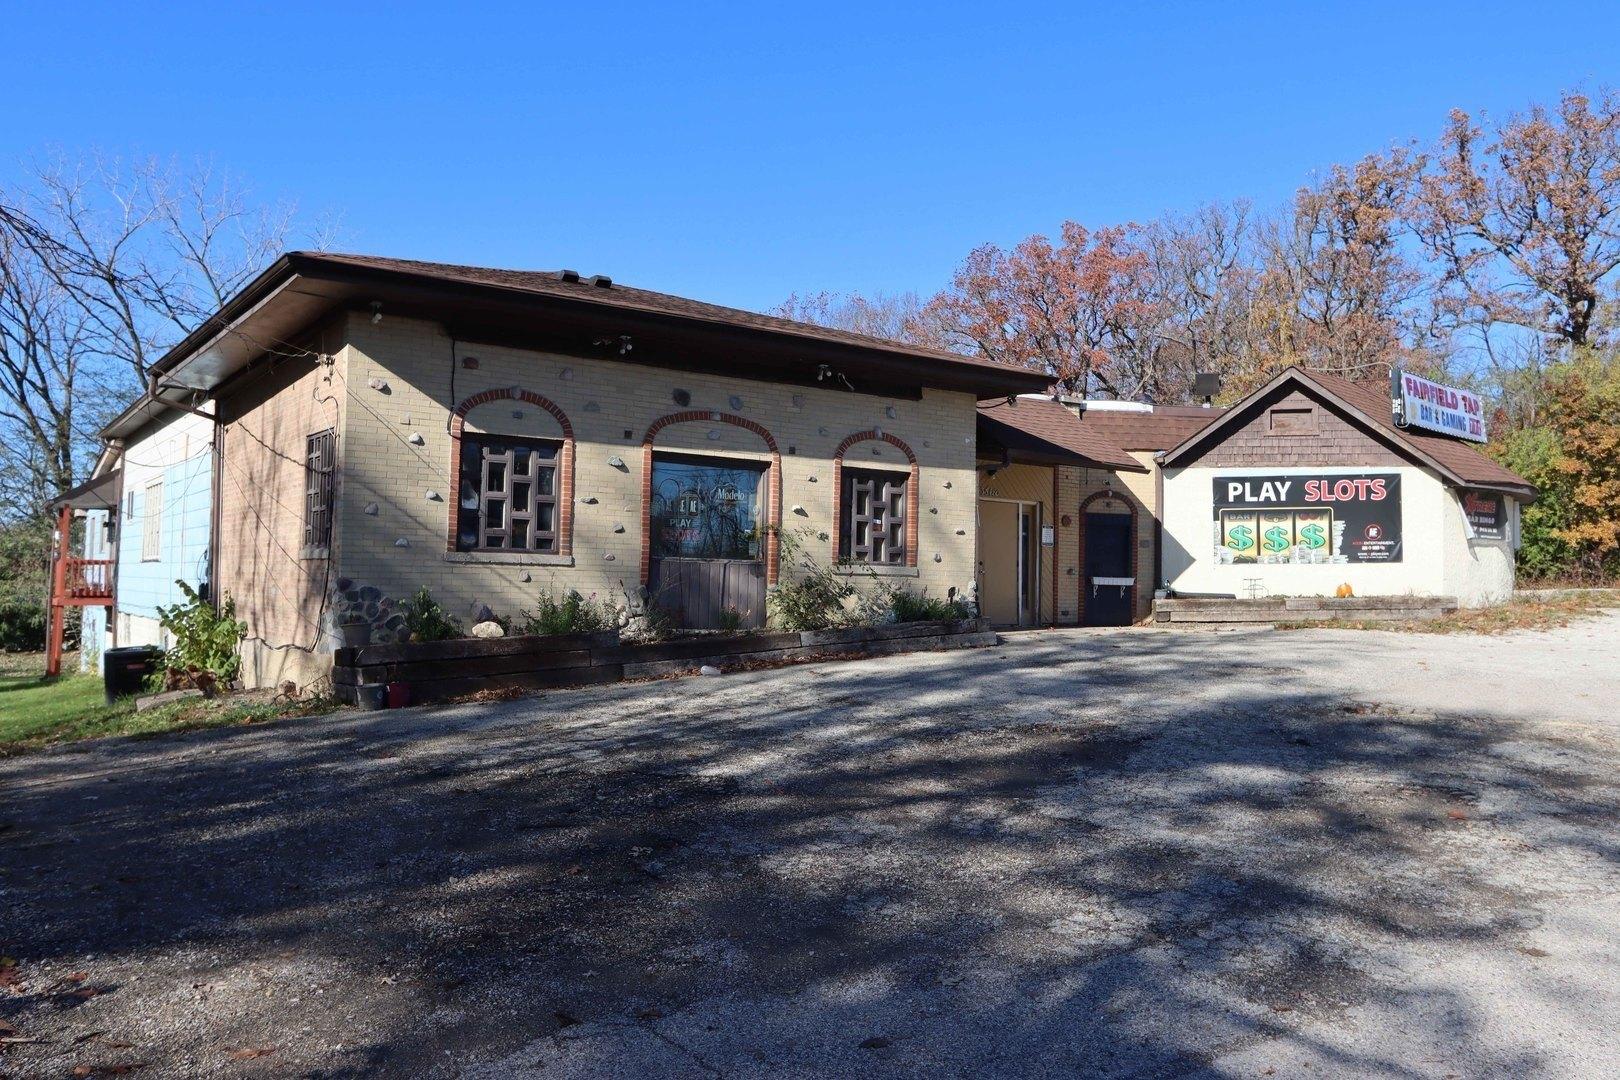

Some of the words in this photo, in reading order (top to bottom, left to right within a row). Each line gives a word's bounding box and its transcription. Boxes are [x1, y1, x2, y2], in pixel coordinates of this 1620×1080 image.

[1405, 377, 1458, 410] FAIRFIELD
[1461, 395, 1479, 416] TAP
[1420, 404, 1433, 423] BAR
[1441, 411, 1467, 431] GAMING
[717, 488, 745, 500] Modelo
[1228, 481, 1291, 502] PLAY
[1304, 479, 1387, 501] SLOTS
[670, 519, 691, 527] PLAY
